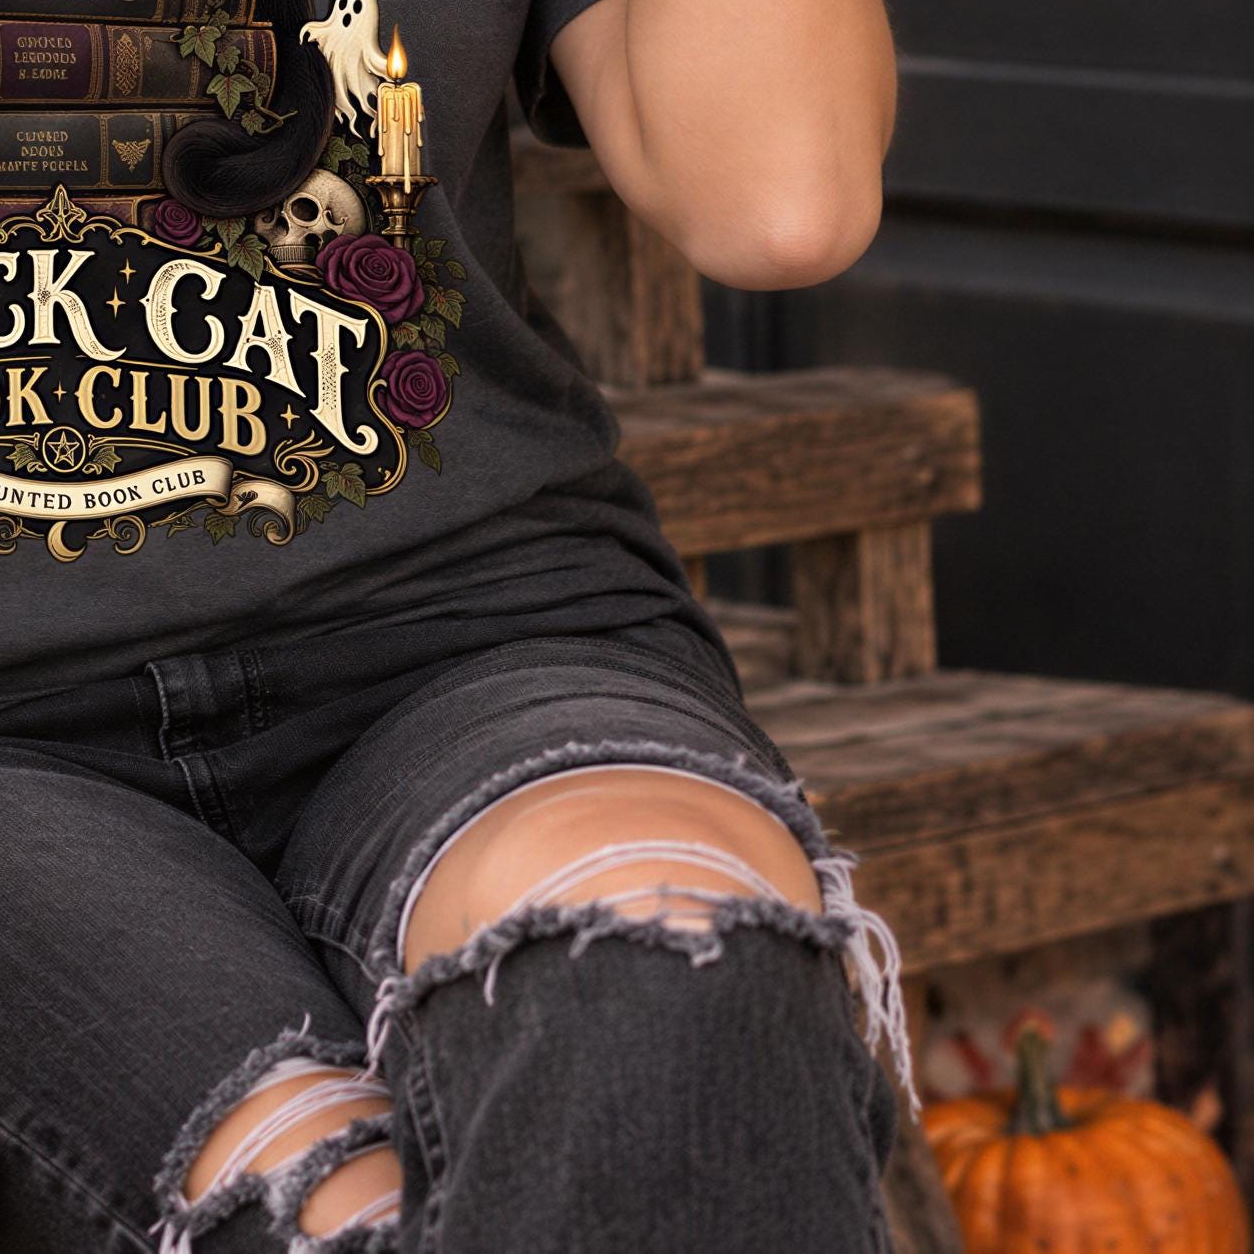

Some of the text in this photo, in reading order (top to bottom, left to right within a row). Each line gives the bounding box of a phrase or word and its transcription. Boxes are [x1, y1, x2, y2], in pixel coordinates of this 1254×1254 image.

[143, 258, 378, 454] CAT
[75, 366, 267, 455] CLUB
[151, 469, 206, 494] CLUB
